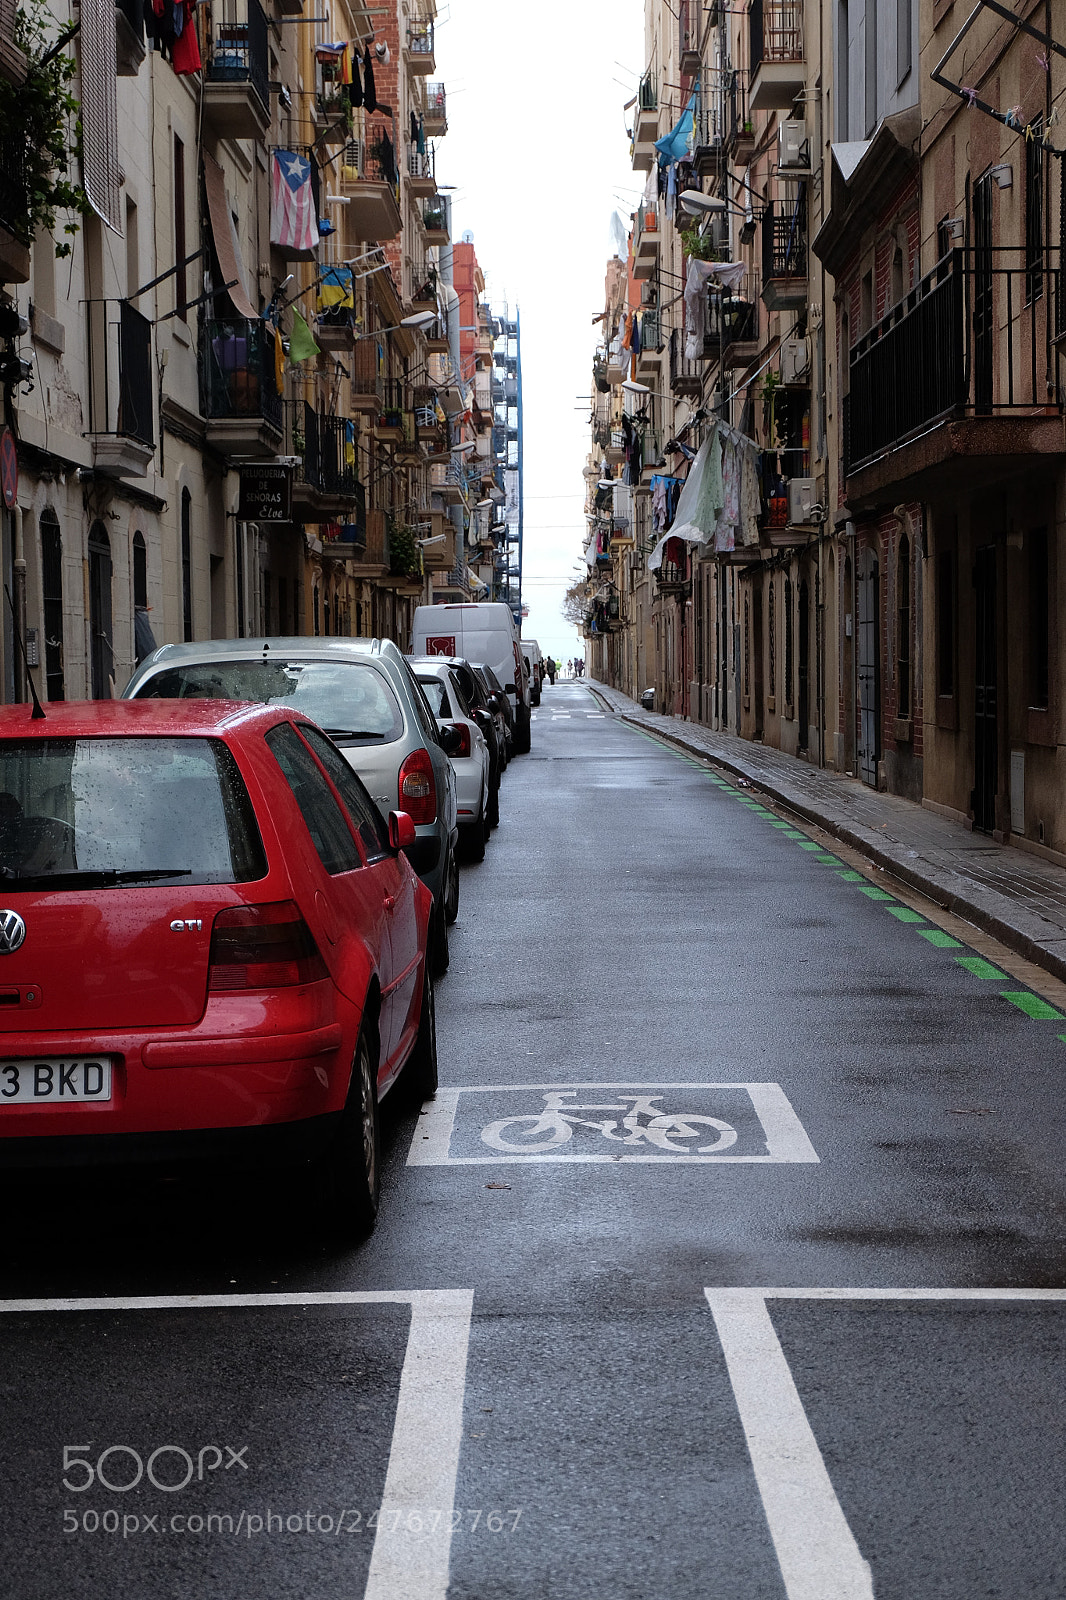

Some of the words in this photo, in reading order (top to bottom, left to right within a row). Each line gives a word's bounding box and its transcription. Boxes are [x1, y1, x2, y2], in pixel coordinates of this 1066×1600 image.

[258, 481, 268, 490] DE
[170, 919, 203, 932] GTI
[33, 1062, 104, 1097] BKD
